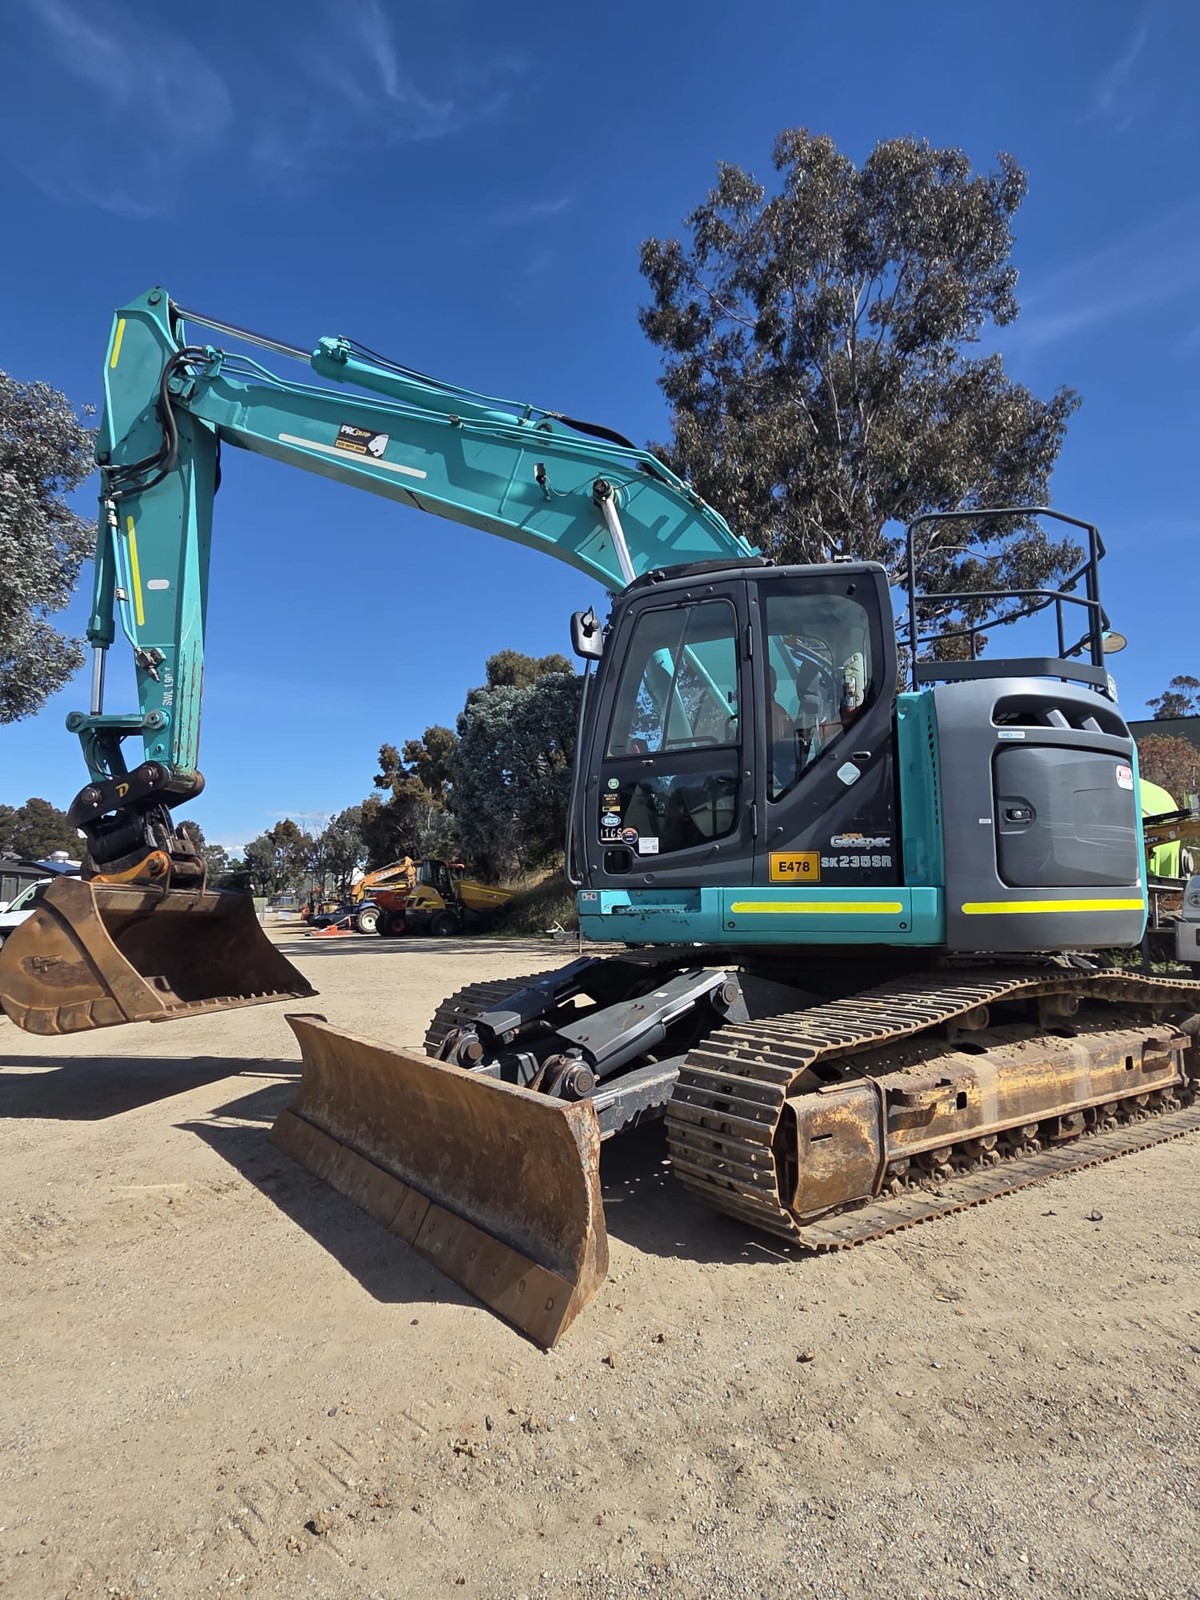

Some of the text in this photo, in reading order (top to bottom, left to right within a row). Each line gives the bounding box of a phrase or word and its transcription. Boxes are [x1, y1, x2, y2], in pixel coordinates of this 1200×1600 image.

[830, 835, 891, 850] Geospec
[778, 861, 811, 873] E478
[820, 855, 892, 868] SK235SR
